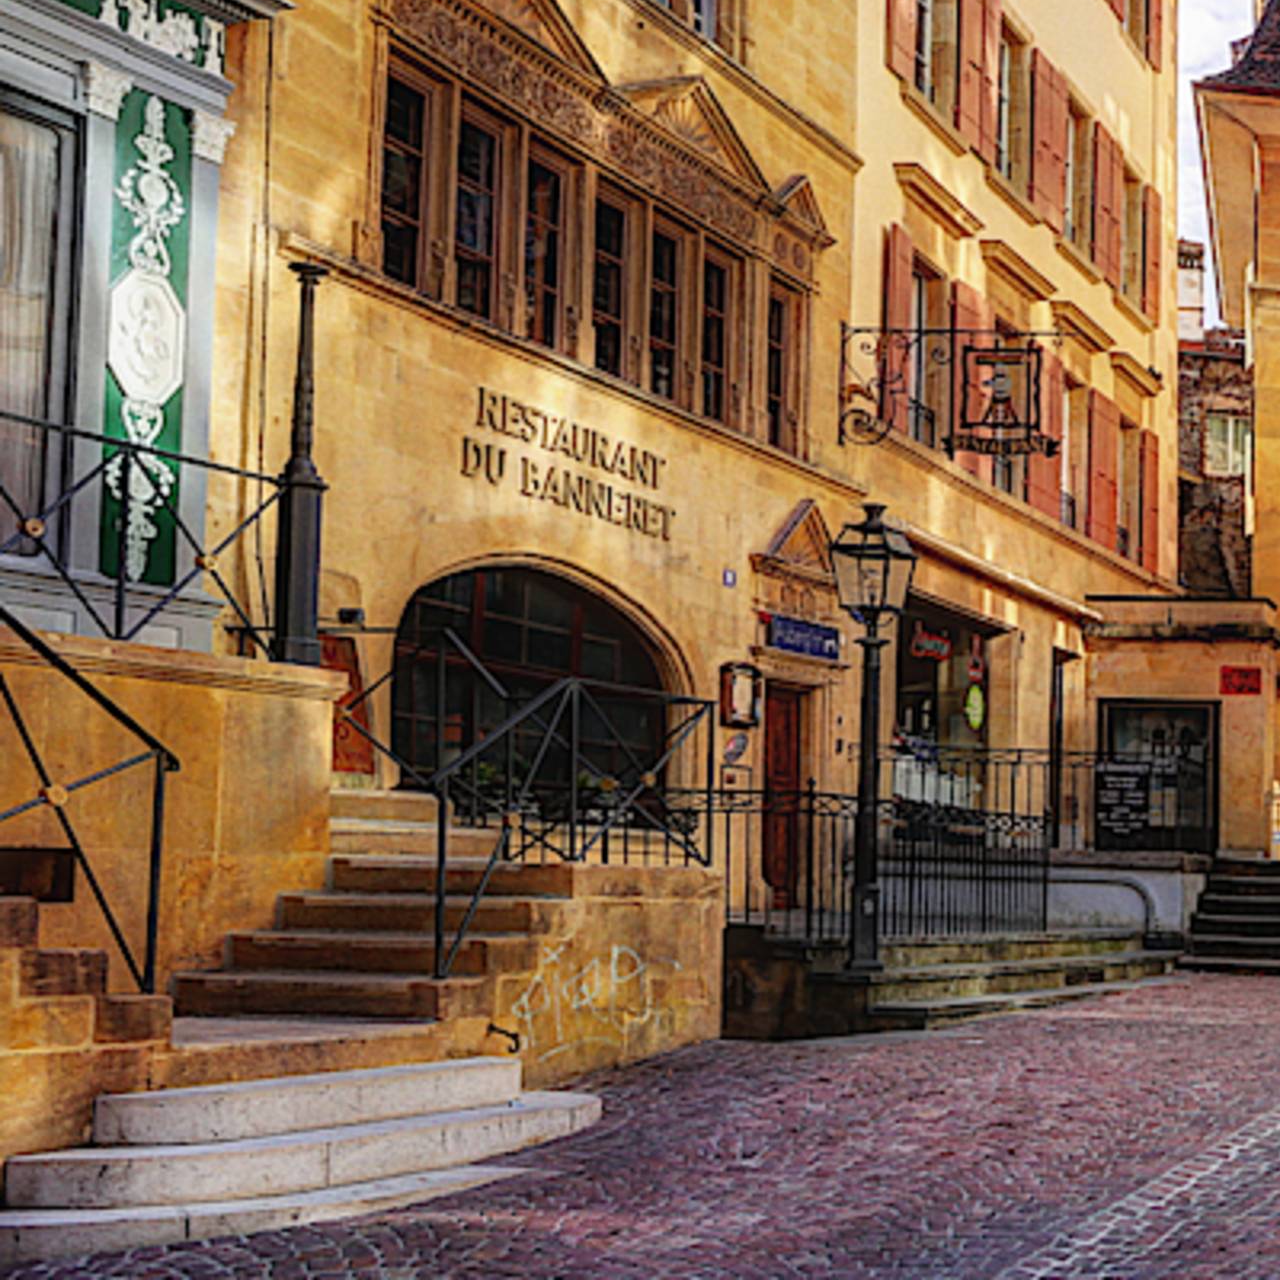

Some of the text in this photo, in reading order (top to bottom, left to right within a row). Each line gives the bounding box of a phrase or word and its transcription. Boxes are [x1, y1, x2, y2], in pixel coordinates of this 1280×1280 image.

[460, 436, 676, 541] DU BANNERET
[475, 386, 667, 490] RESTAURANT
